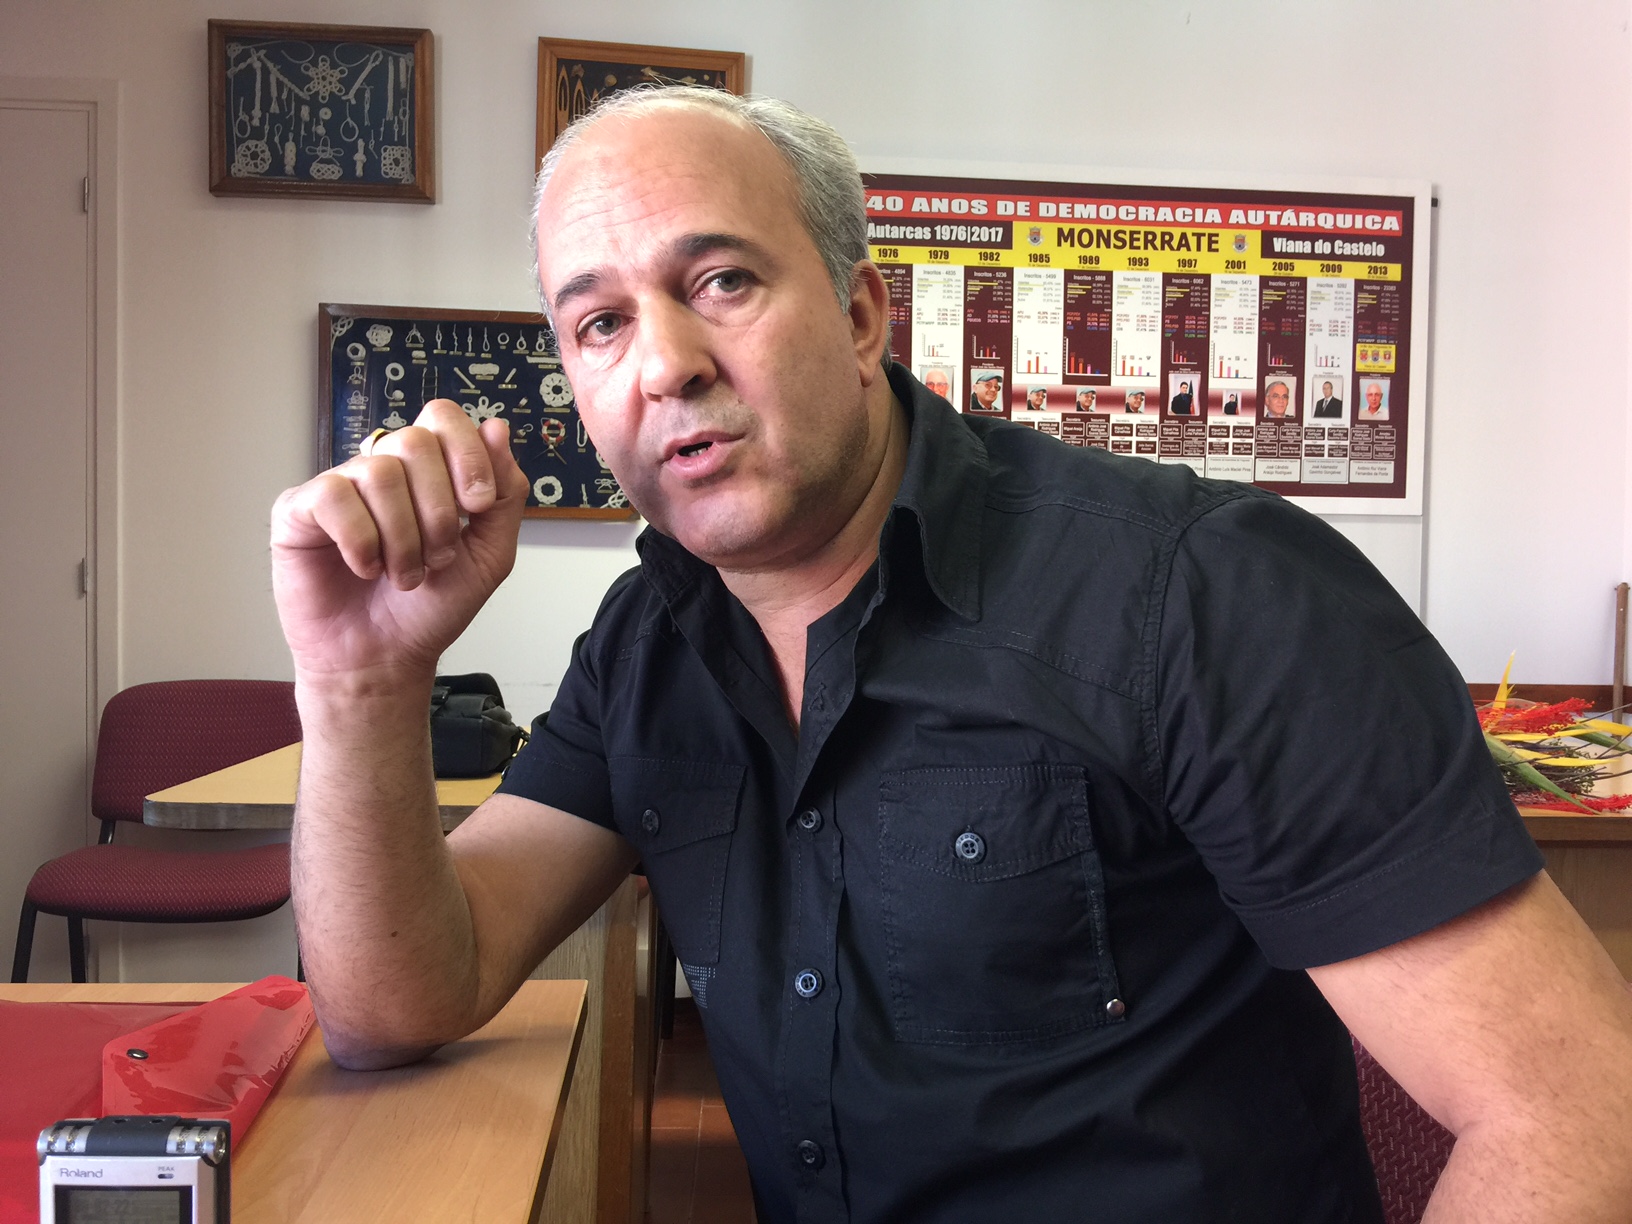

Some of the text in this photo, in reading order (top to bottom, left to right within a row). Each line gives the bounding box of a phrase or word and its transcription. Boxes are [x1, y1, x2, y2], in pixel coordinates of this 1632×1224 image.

[866, 195, 1400, 231] 40 ANOS DE DEMOCRACIA AUTÁRQUICA
[867, 222, 932, 240] Autarcas
[1056, 227, 1220, 253] MONSERRATE
[1272, 237, 1385, 257] Viana do Castelo
[877, 248, 1388, 275] 1976 1979 1982 1985 1989 1993 1997 2001 2005 2009 2013
[60, 1168, 103, 1179] Roland
